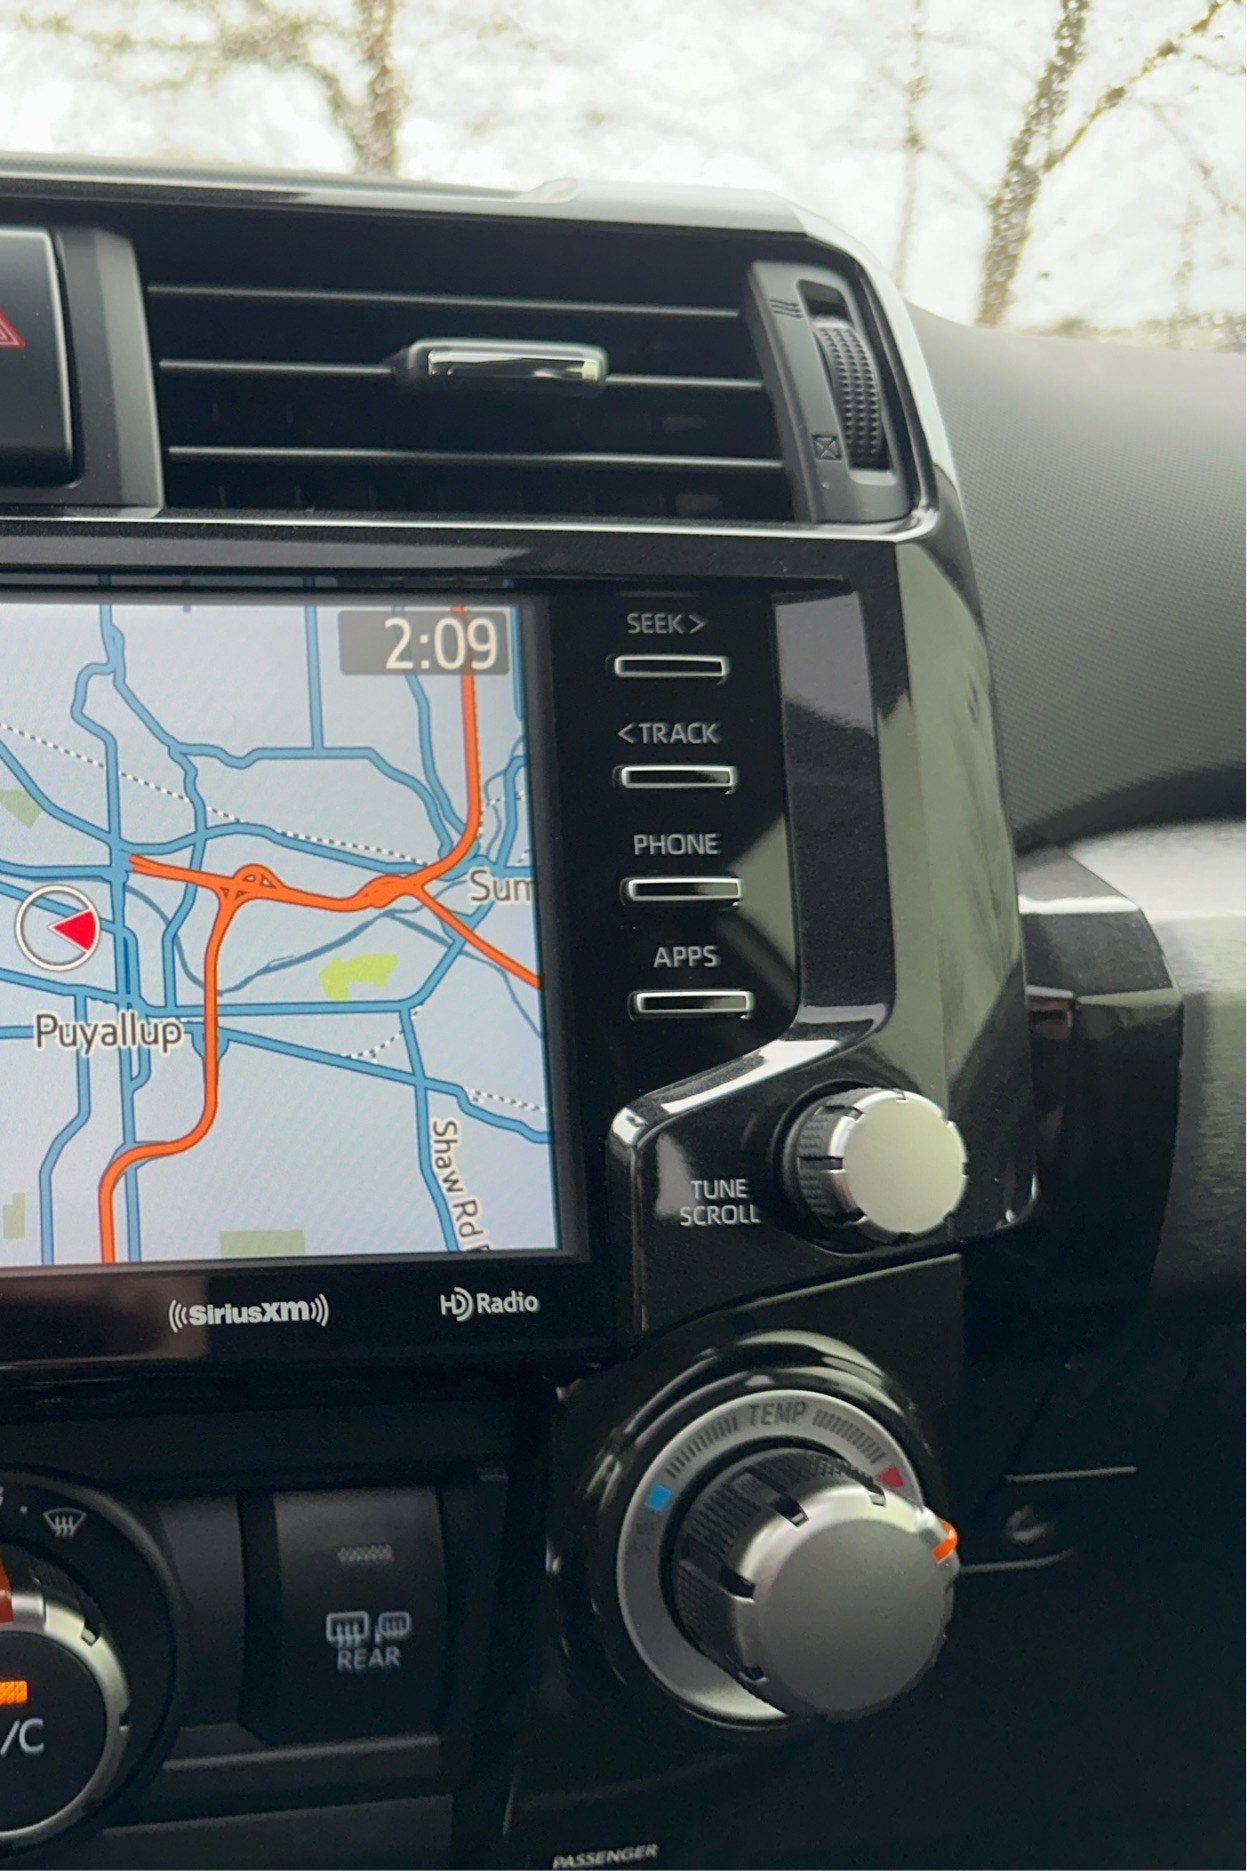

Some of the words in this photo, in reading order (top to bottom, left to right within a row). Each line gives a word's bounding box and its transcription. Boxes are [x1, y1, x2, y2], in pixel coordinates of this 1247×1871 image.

[384, 617, 498, 670] 2:09
[633, 833, 720, 855] PHONE
[653, 945, 720, 968] APPS
[36, 1012, 182, 1055] Puyallup
[432, 1120, 463, 1193] Shaw
[452, 1199, 484, 1238] Rd
[690, 1179, 748, 1199] TUNE
[679, 1205, 760, 1228] SCROLL
[476, 1289, 540, 1316] Radio
[749, 1400, 807, 1426] TEMP
[337, 1645, 402, 1671] REAR
[552, 1843, 660, 1870] PASSENGER
